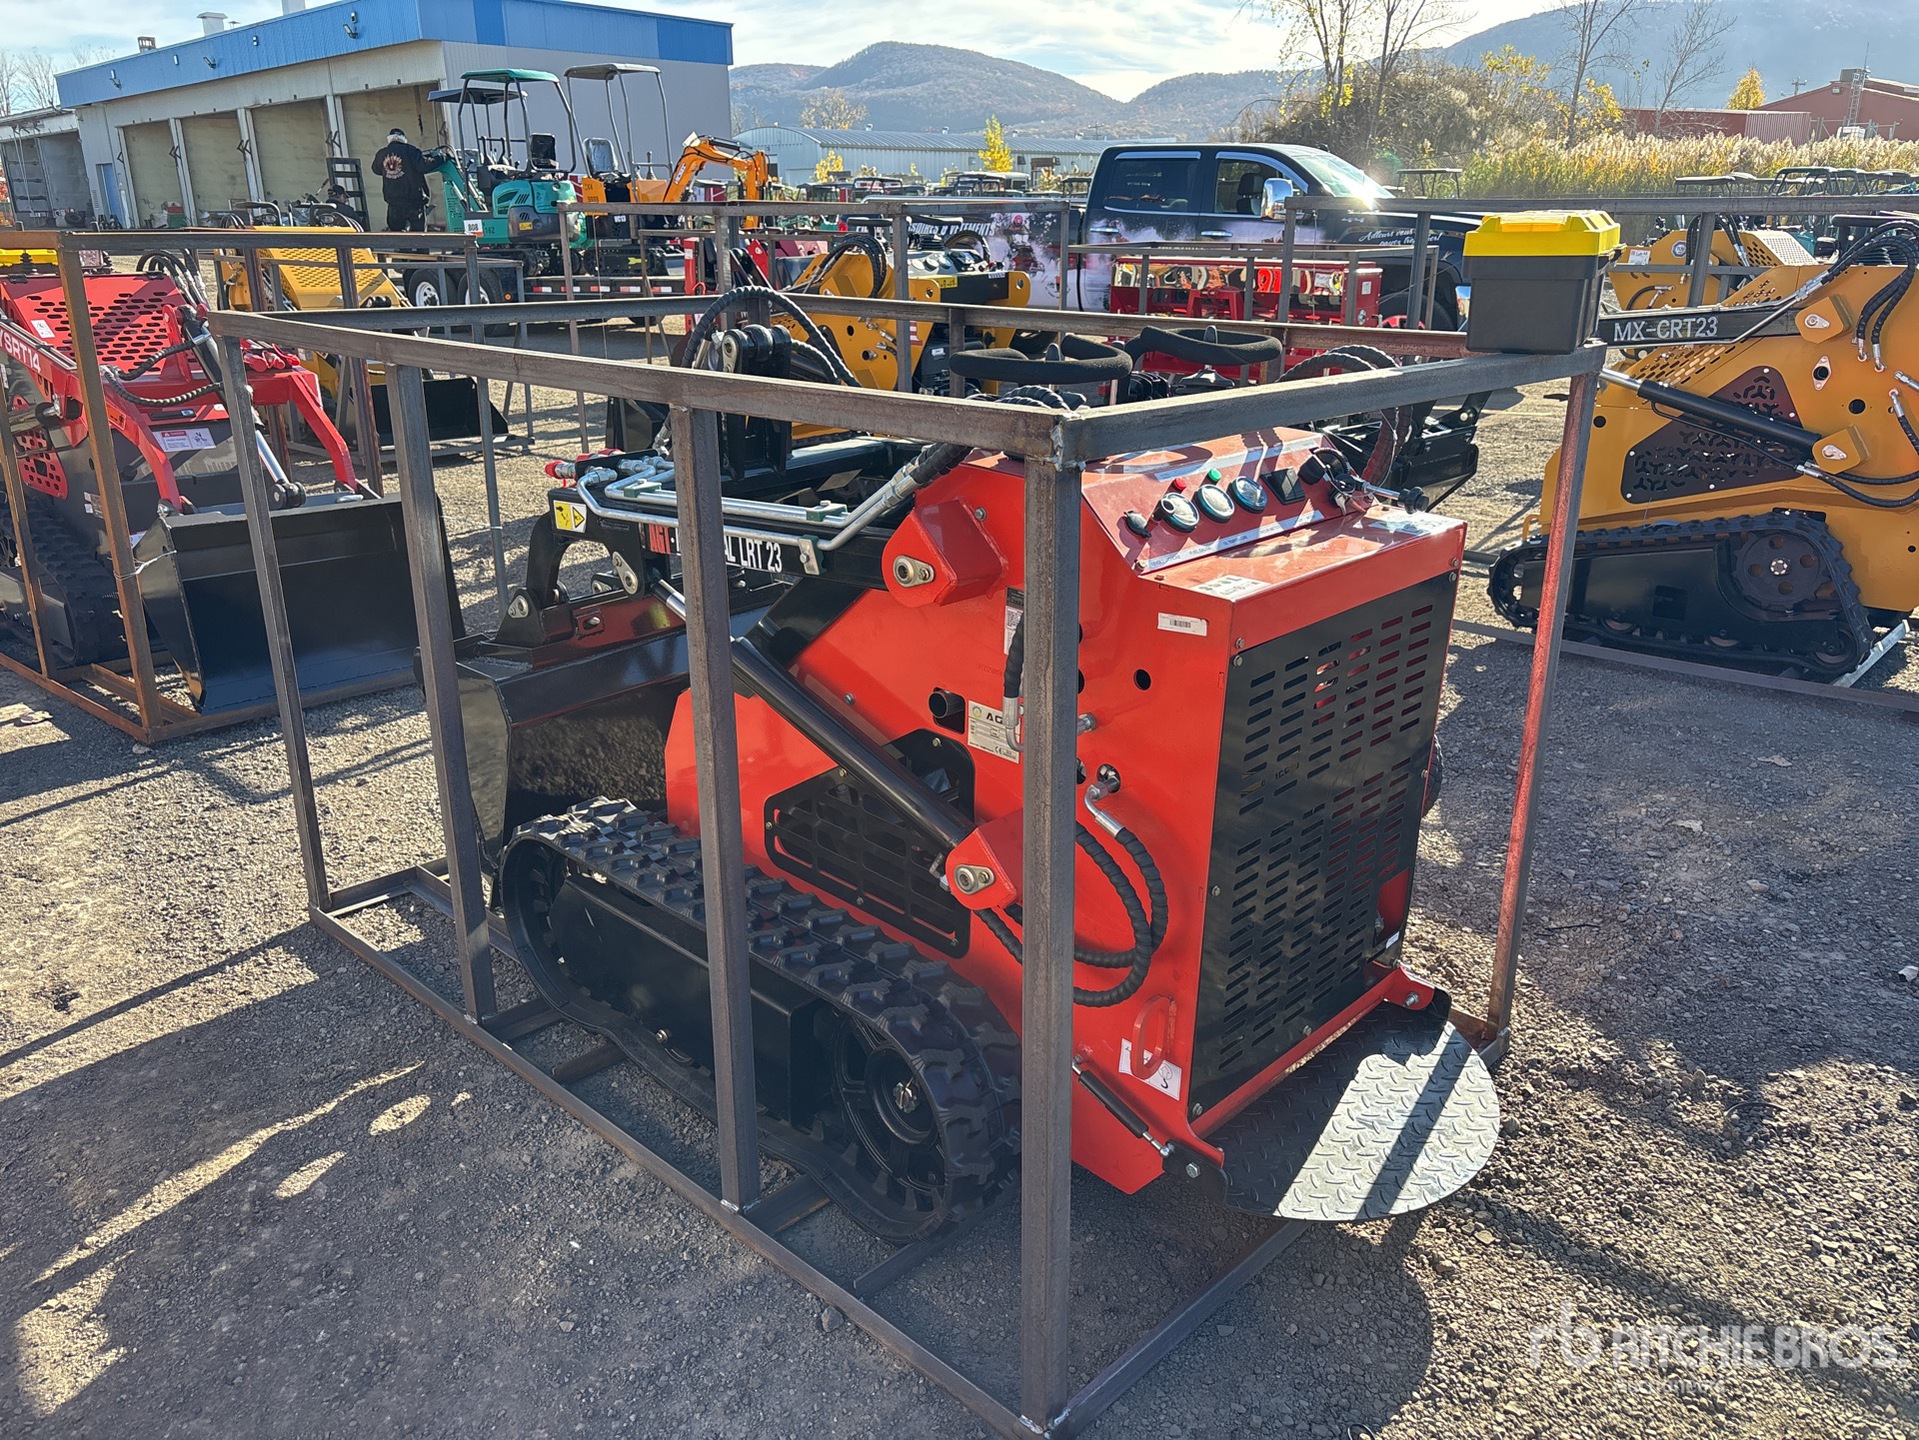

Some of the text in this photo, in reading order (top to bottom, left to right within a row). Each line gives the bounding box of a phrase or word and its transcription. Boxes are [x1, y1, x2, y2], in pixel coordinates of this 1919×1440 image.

[467, 223, 480, 232] 808
[1613, 316, 1719, 342] MX-CRT23
[649, 523, 671, 555] AGT
[738, 537, 763, 569] LRT
[765, 541, 783, 573] 23
[986, 712, 1003, 724] AG
